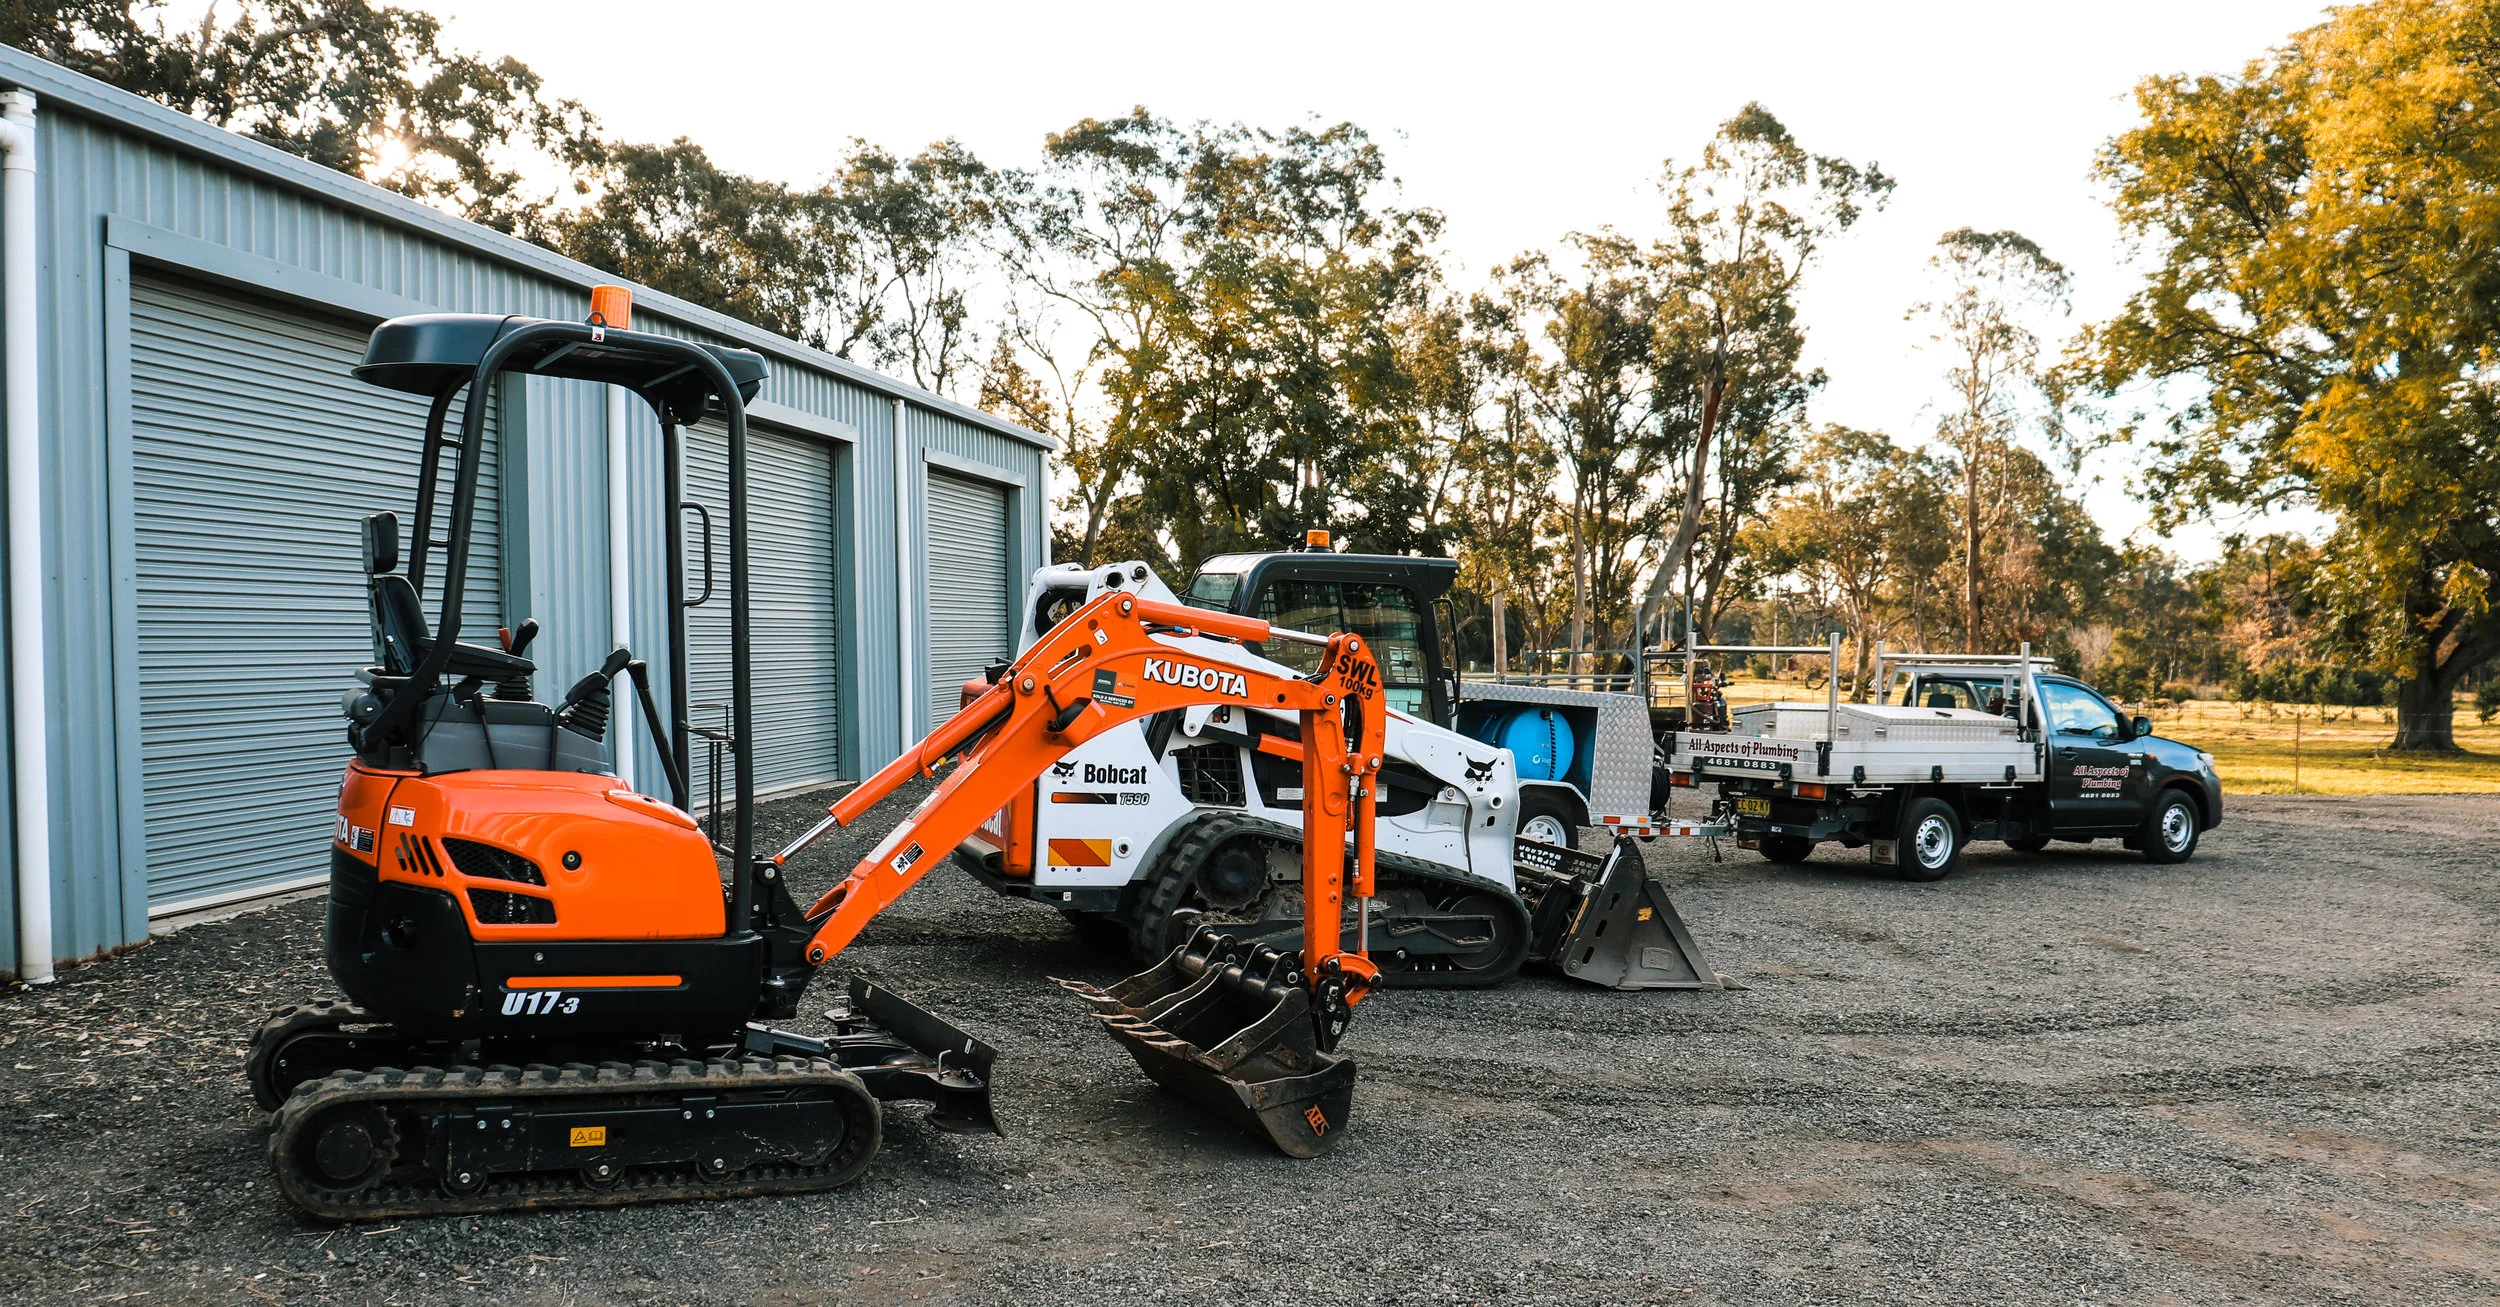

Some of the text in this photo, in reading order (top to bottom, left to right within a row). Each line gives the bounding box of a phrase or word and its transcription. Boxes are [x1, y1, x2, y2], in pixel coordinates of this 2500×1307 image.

[1143, 657, 1248, 698] KUBOTA
[1337, 654, 1377, 687] SWL
[1339, 676, 1374, 700] 100kg
[1688, 738, 1799, 761] All Aspects of Plumbing
[1084, 764, 1147, 784] Bobcat
[1707, 757, 1776, 770] 4681 0883
[2073, 765, 2130, 777] All Aspects of
[2081, 778, 2122, 790] Plumbing
[1119, 792, 1150, 806] T590
[501, 990, 580, 1016] U17-3
[1303, 1104, 1331, 1137] ABS
